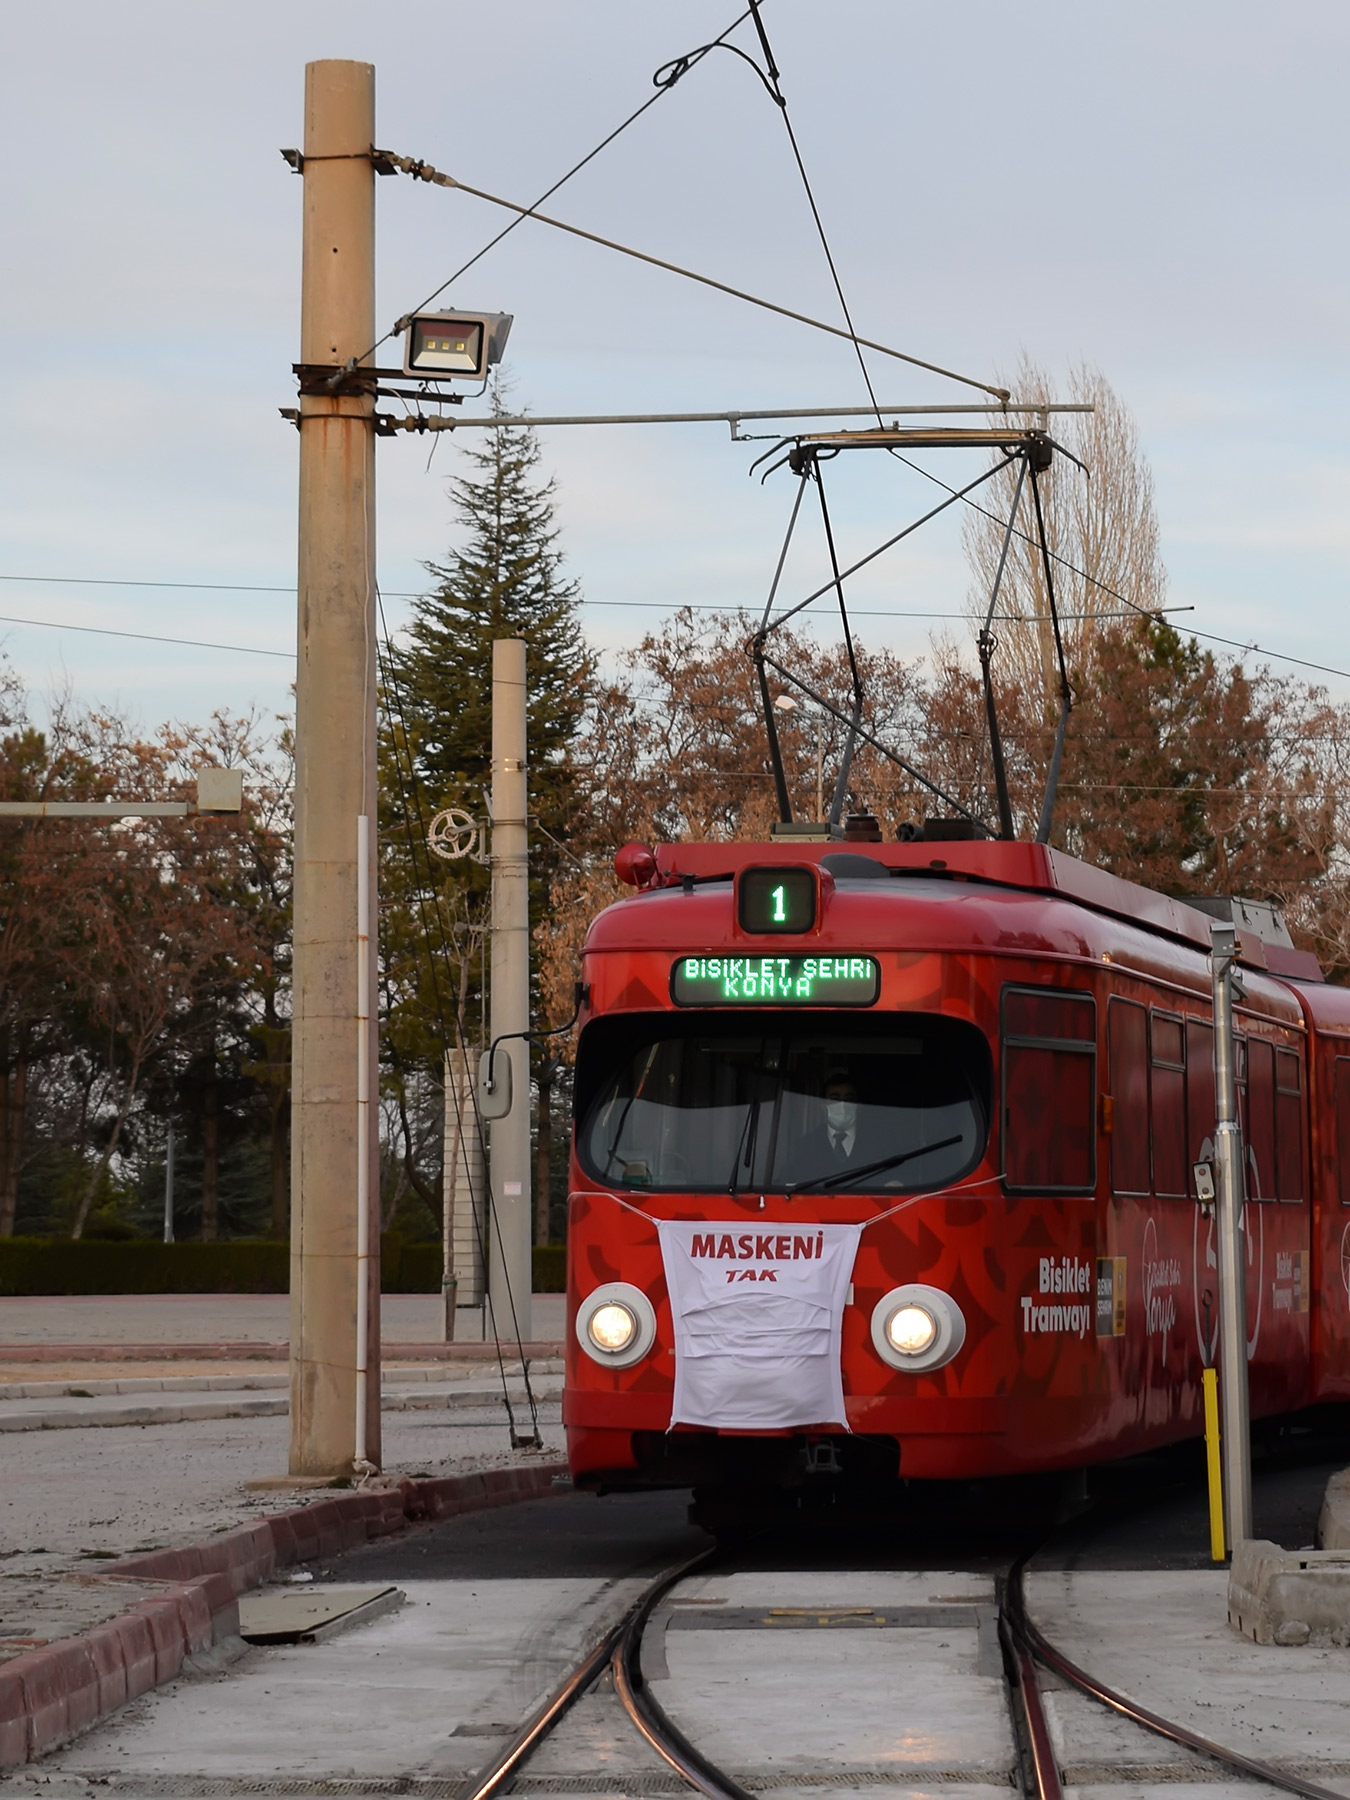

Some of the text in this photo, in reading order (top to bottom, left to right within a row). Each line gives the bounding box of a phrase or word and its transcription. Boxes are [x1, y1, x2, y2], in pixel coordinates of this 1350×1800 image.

[771, 885, 786, 922] 1
[724, 977, 811, 997] KONYA
[691, 1230, 824, 1260] MASKENİ
[725, 1269, 780, 1284] TAK
[1039, 1256, 1090, 1293] Bisiklet
[1020, 1296, 1090, 1340] Tramvayı
[1146, 1270, 1177, 1368] Konya
